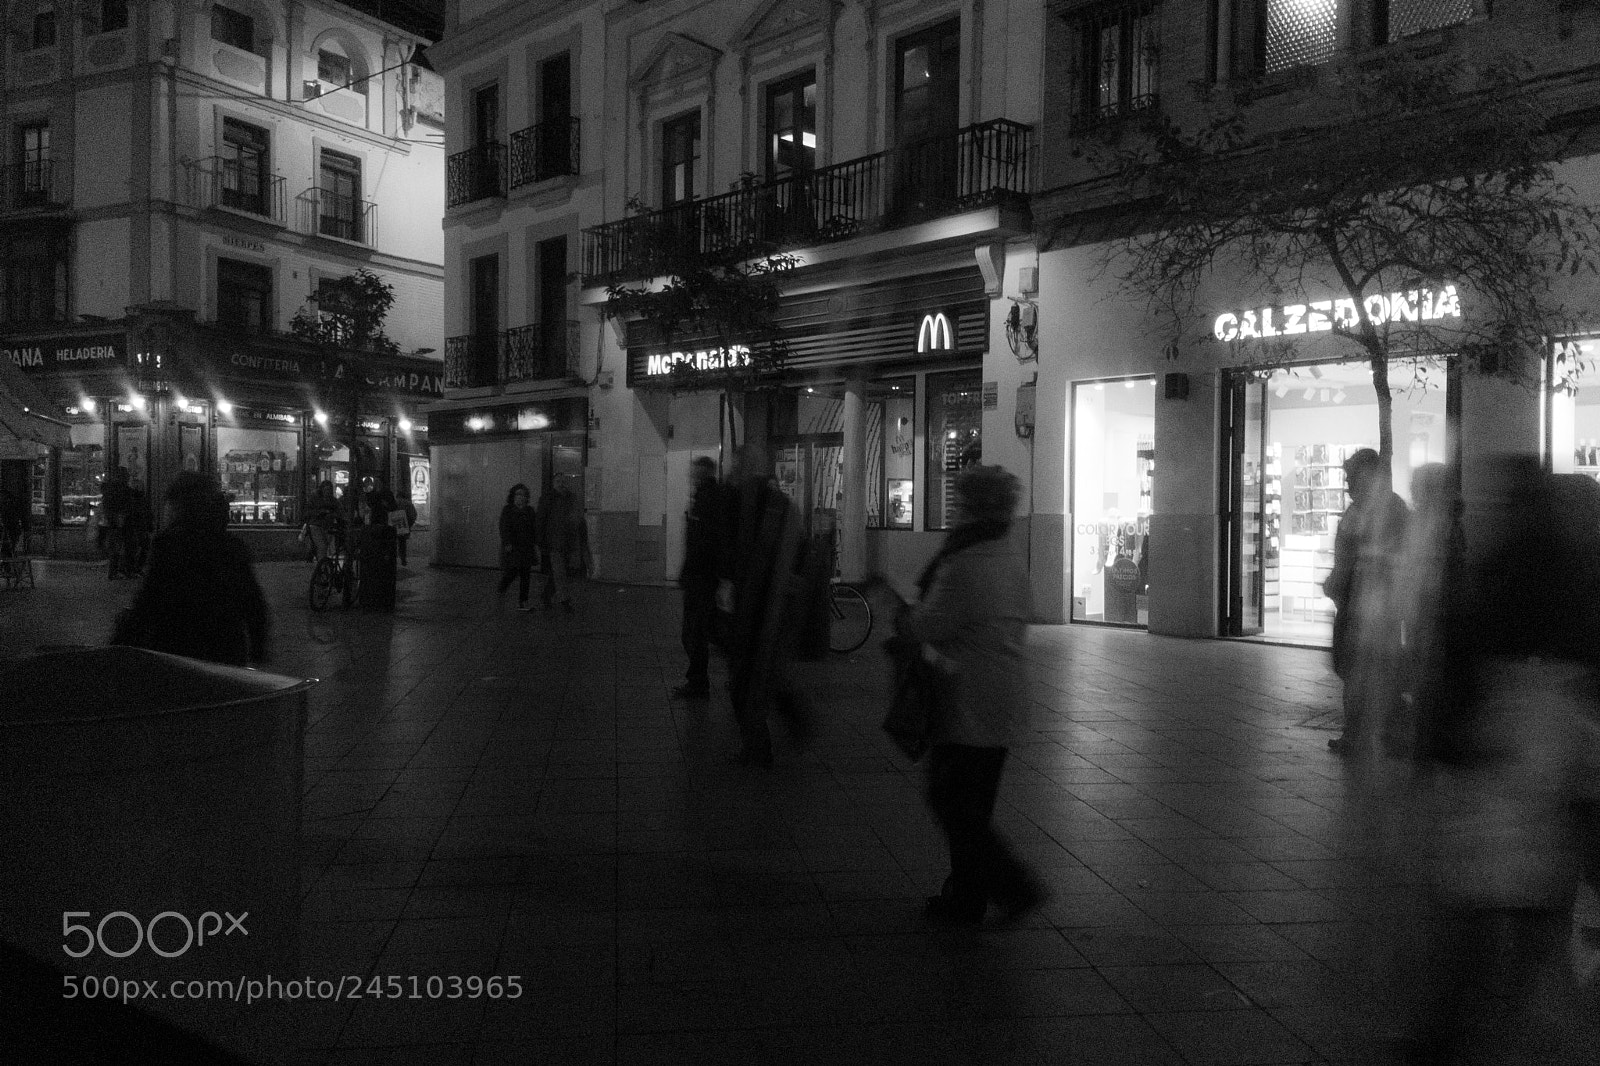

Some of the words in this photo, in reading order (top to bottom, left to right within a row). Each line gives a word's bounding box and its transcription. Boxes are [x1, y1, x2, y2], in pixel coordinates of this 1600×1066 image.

[1214, 285, 1461, 342] CALZEDONIA
[56, 346, 116, 361] HELADERIA
[231, 353, 301, 373] CONFITERIA
[1077, 524, 1116, 535] COLOR
[1118, 523, 1150, 536] YOUR
